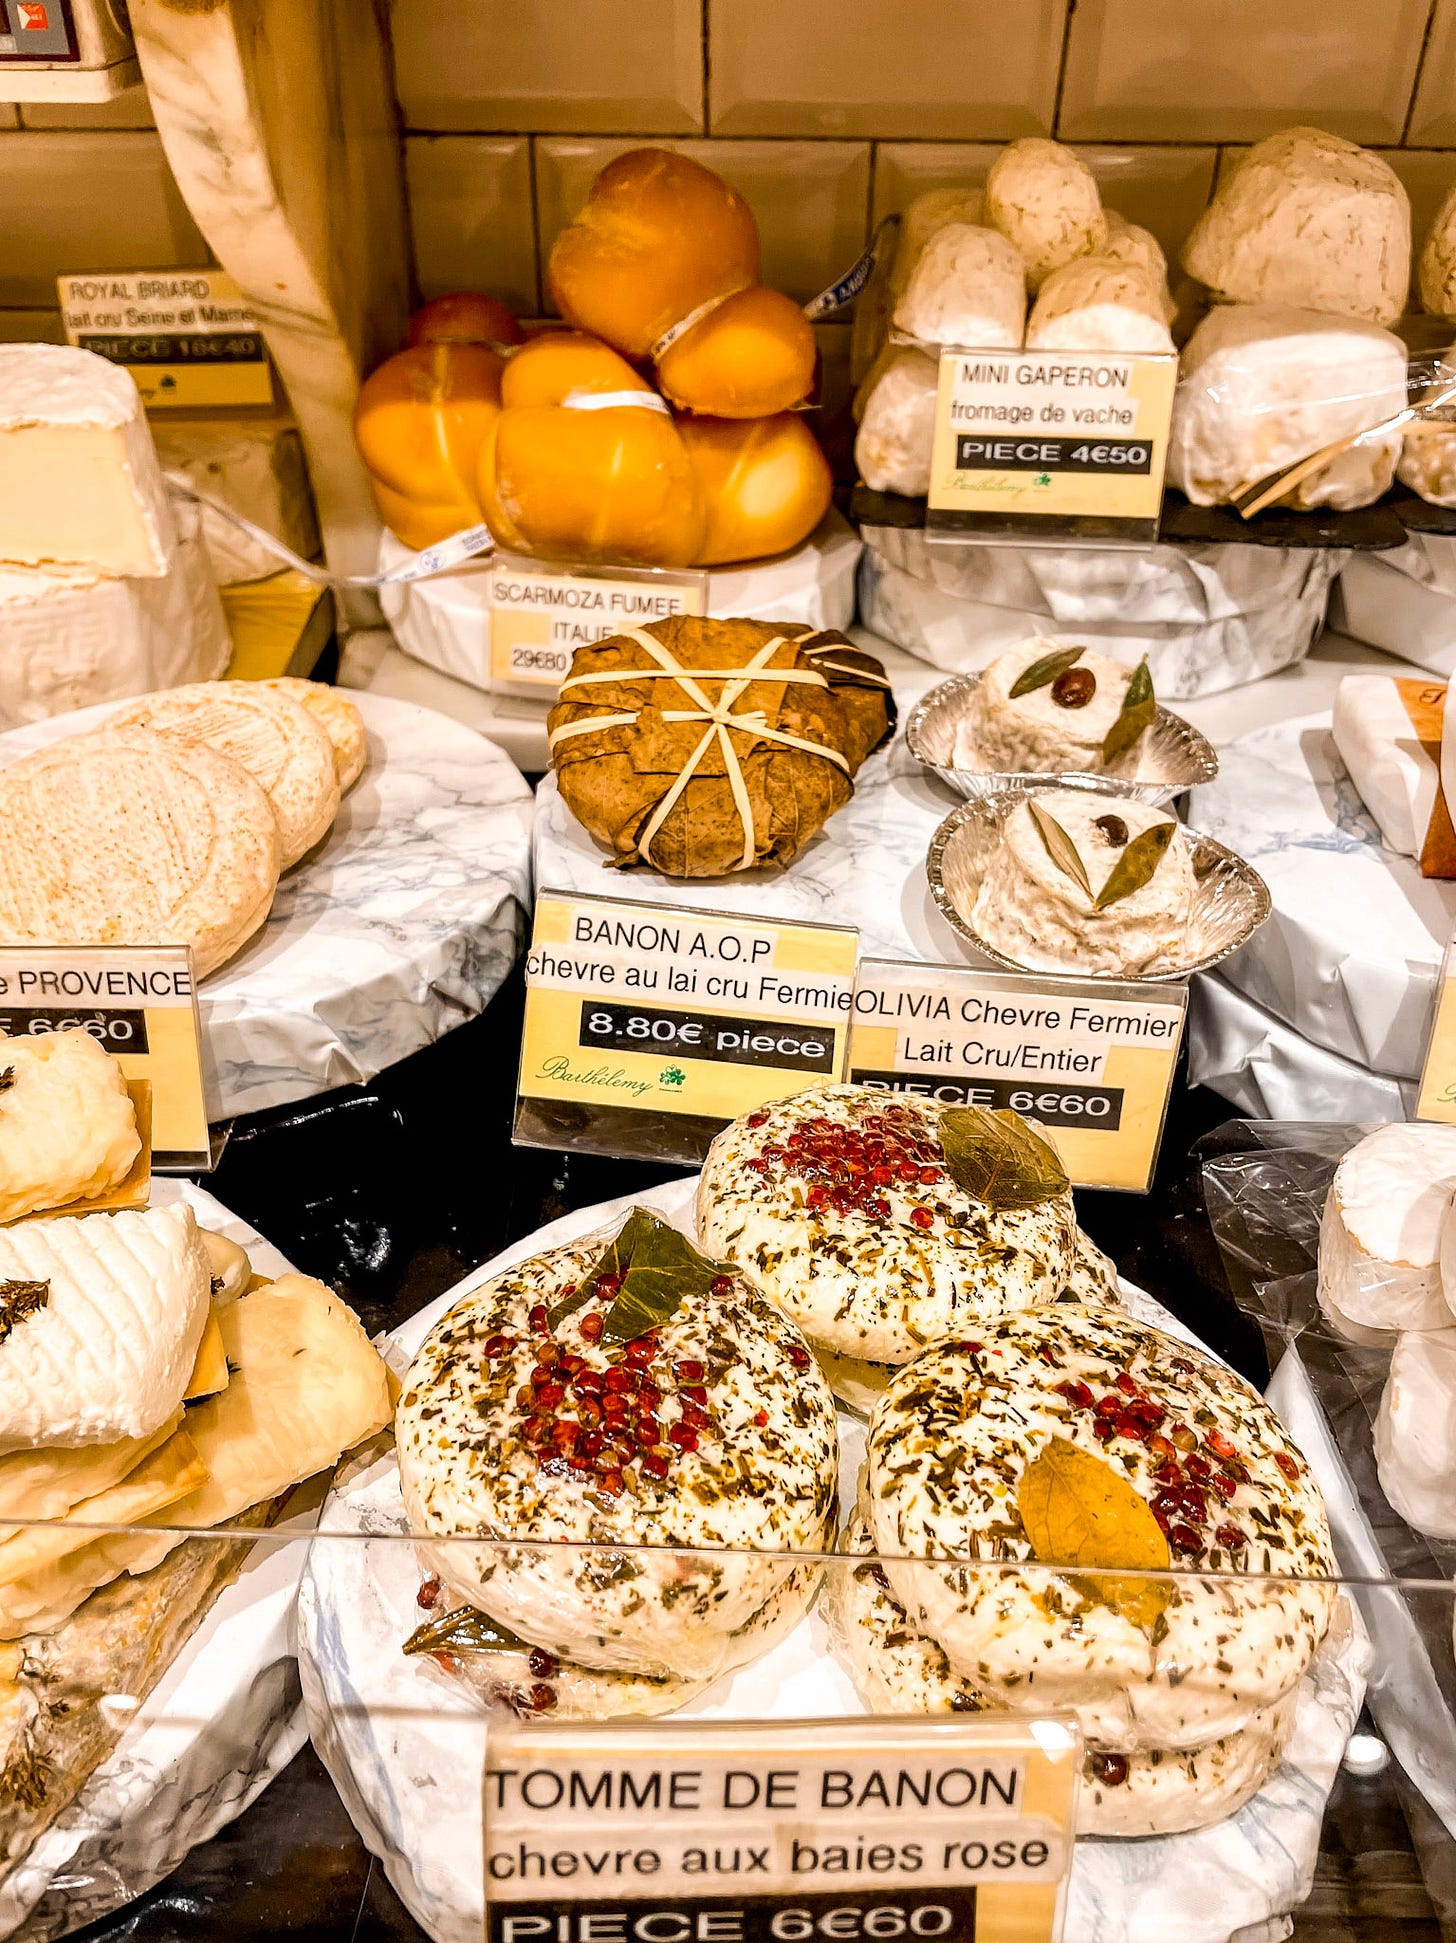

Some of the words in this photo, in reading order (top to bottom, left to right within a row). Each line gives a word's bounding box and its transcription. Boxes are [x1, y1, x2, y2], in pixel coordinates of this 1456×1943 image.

[70, 281, 133, 300] ROYAL
[137, 279, 210, 299] BRIARD
[125, 307, 176, 326] Seine
[962, 364, 1009, 384] MINI
[1015, 365, 1129, 388] GAPERON
[951, 400, 1033, 424] fromage
[1040, 403, 1066, 422] de
[1072, 405, 1134, 425] vache
[962, 442, 1062, 462] PIECE
[1070, 446, 1148, 465] 4€50
[494, 583, 605, 610] SCARMOZA
[611, 594, 681, 617] FUMEE
[554, 622, 614, 642] ITALIE
[512, 649, 567, 671] 29€80
[575, 917, 679, 954] BANON
[689, 932, 771, 964] A.O.P
[18, 970, 192, 996] PROVENCE
[526, 951, 615, 984] chevre
[625, 967, 658, 989] au
[668, 966, 697, 993] lai
[706, 977, 748, 999] cru
[855, 989, 951, 1021] OLIVIA
[961, 998, 1061, 1030] Chevre
[1070, 1007, 1179, 1039] Fermier
[588, 1012, 703, 1045] 8.80€
[716, 1030, 827, 1059] piece
[904, 1037, 954, 1064] Lait
[963, 1041, 1102, 1073] Cru/Entier
[535, 1055, 653, 1097] Barthélemy
[1008, 1090, 1111, 1117] 6€60
[484, 1768, 702, 1810] TOMME
[723, 1769, 799, 1809] DE
[820, 1766, 1018, 1809] BANON
[488, 1842, 662, 1881] chevre
[681, 1844, 769, 1875] aux
[791, 1834, 924, 1875] baies
[942, 1835, 1050, 1872] rose
[502, 1911, 744, 1943] PIECE
[770, 1904, 953, 1941] 6€60
